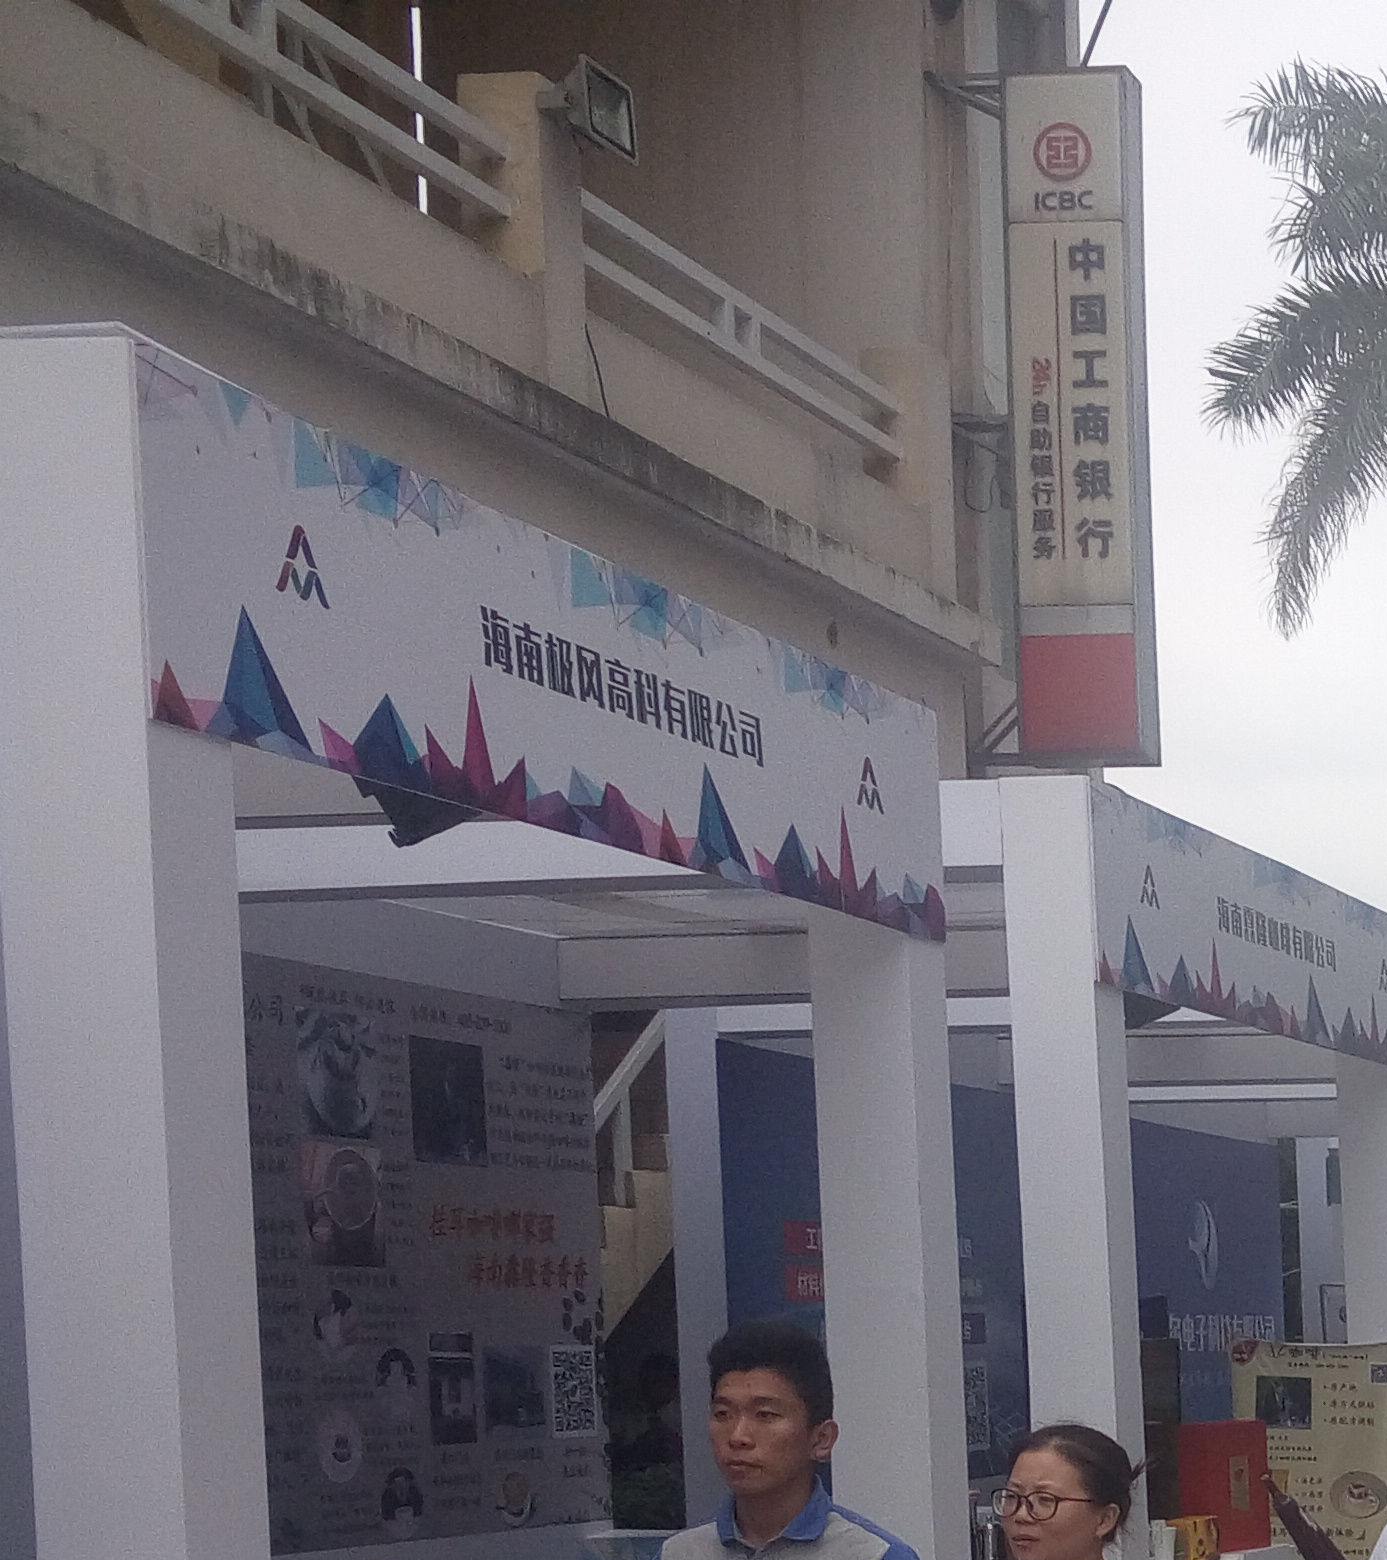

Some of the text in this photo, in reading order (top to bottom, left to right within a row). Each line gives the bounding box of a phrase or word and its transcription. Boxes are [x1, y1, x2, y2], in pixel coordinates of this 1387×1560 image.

[1034, 190, 1094, 211] ICBC
[1068, 238, 1114, 559] 中国工商银行
[480, 604, 765, 768] 海南极风高科有限公司
